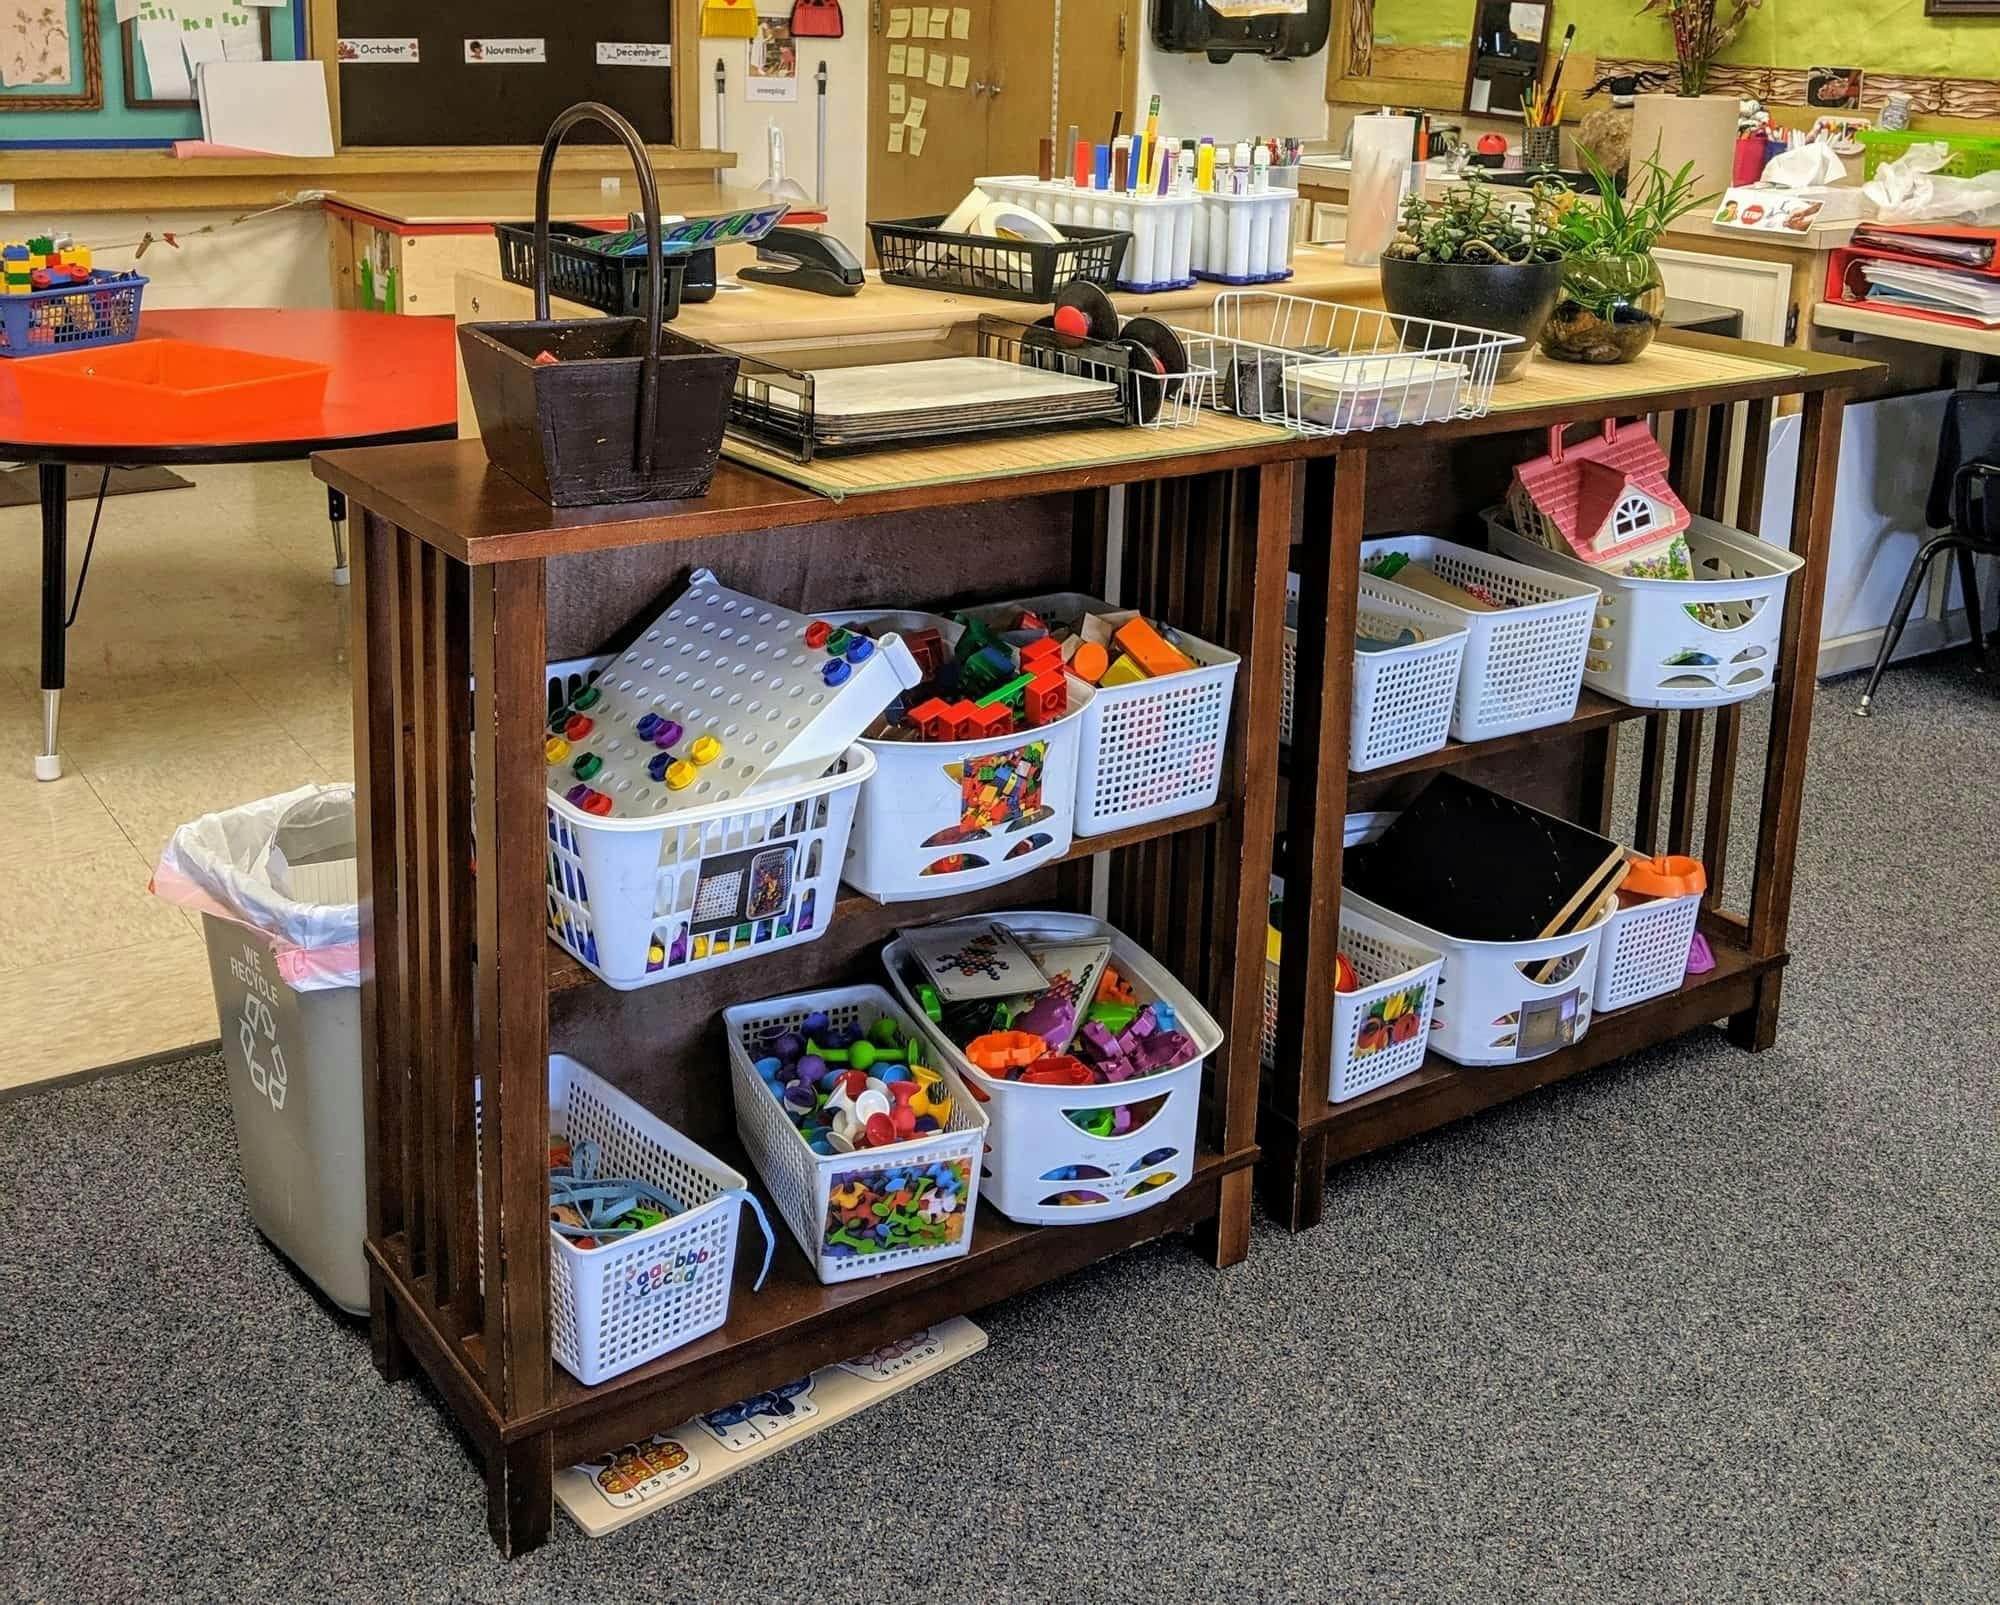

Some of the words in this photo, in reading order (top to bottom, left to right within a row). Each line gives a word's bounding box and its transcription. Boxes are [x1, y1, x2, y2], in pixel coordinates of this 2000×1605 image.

[361, 44, 405, 54] October
[486, 45, 536, 55] November
[616, 47, 661, 57] December
[243, 944, 261, 972] WE
[230, 957, 279, 1008] RECYCLE
[768, 1420, 778, 1429] 3
[651, 1478, 660, 1487] 5
[679, 1464, 690, 1472] 9
